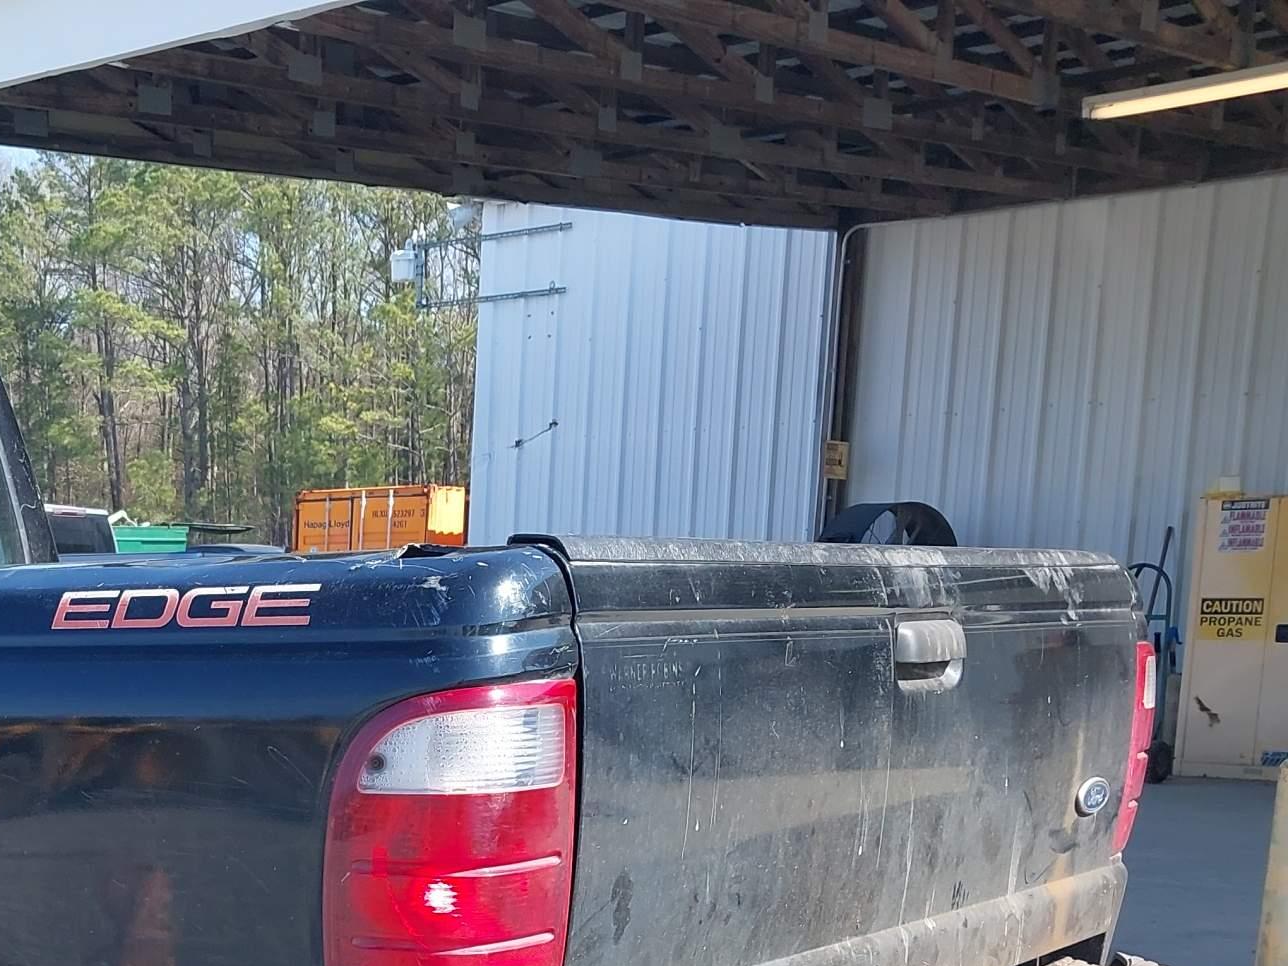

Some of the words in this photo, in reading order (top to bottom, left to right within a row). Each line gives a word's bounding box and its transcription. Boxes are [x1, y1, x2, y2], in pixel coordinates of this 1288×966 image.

[51, 583, 322, 630] EDGE
[1202, 600, 1263, 613] CAUTION
[1199, 616, 1263, 627] PROPANE
[1216, 627, 1243, 638] GAS
